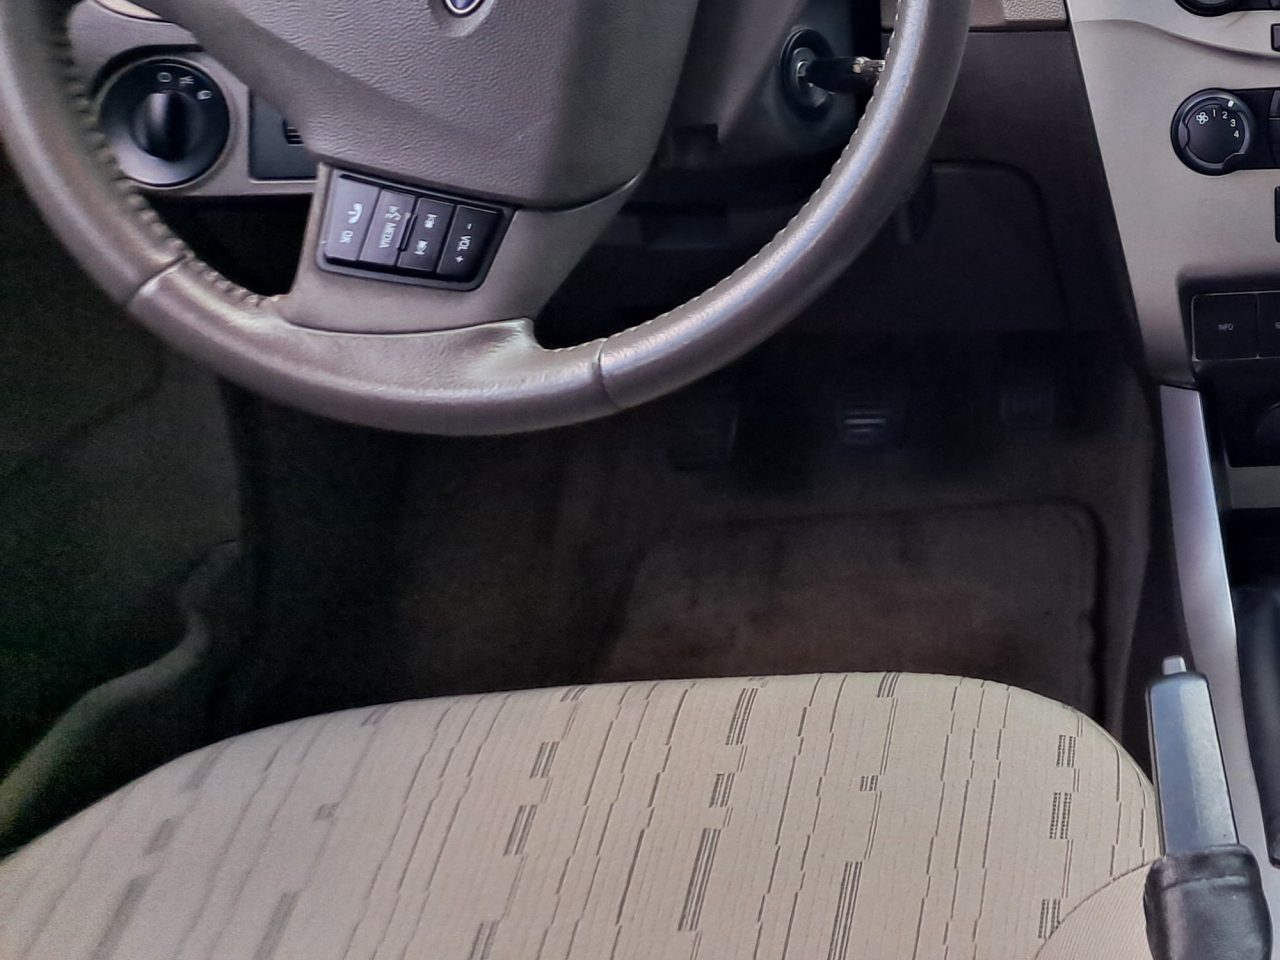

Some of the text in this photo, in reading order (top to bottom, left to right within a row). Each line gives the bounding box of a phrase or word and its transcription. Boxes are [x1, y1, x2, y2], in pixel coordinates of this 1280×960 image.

[340, 230, 353, 244] OK
[378, 222, 397, 249] MEDIA
[457, 235, 472, 252] VOL
